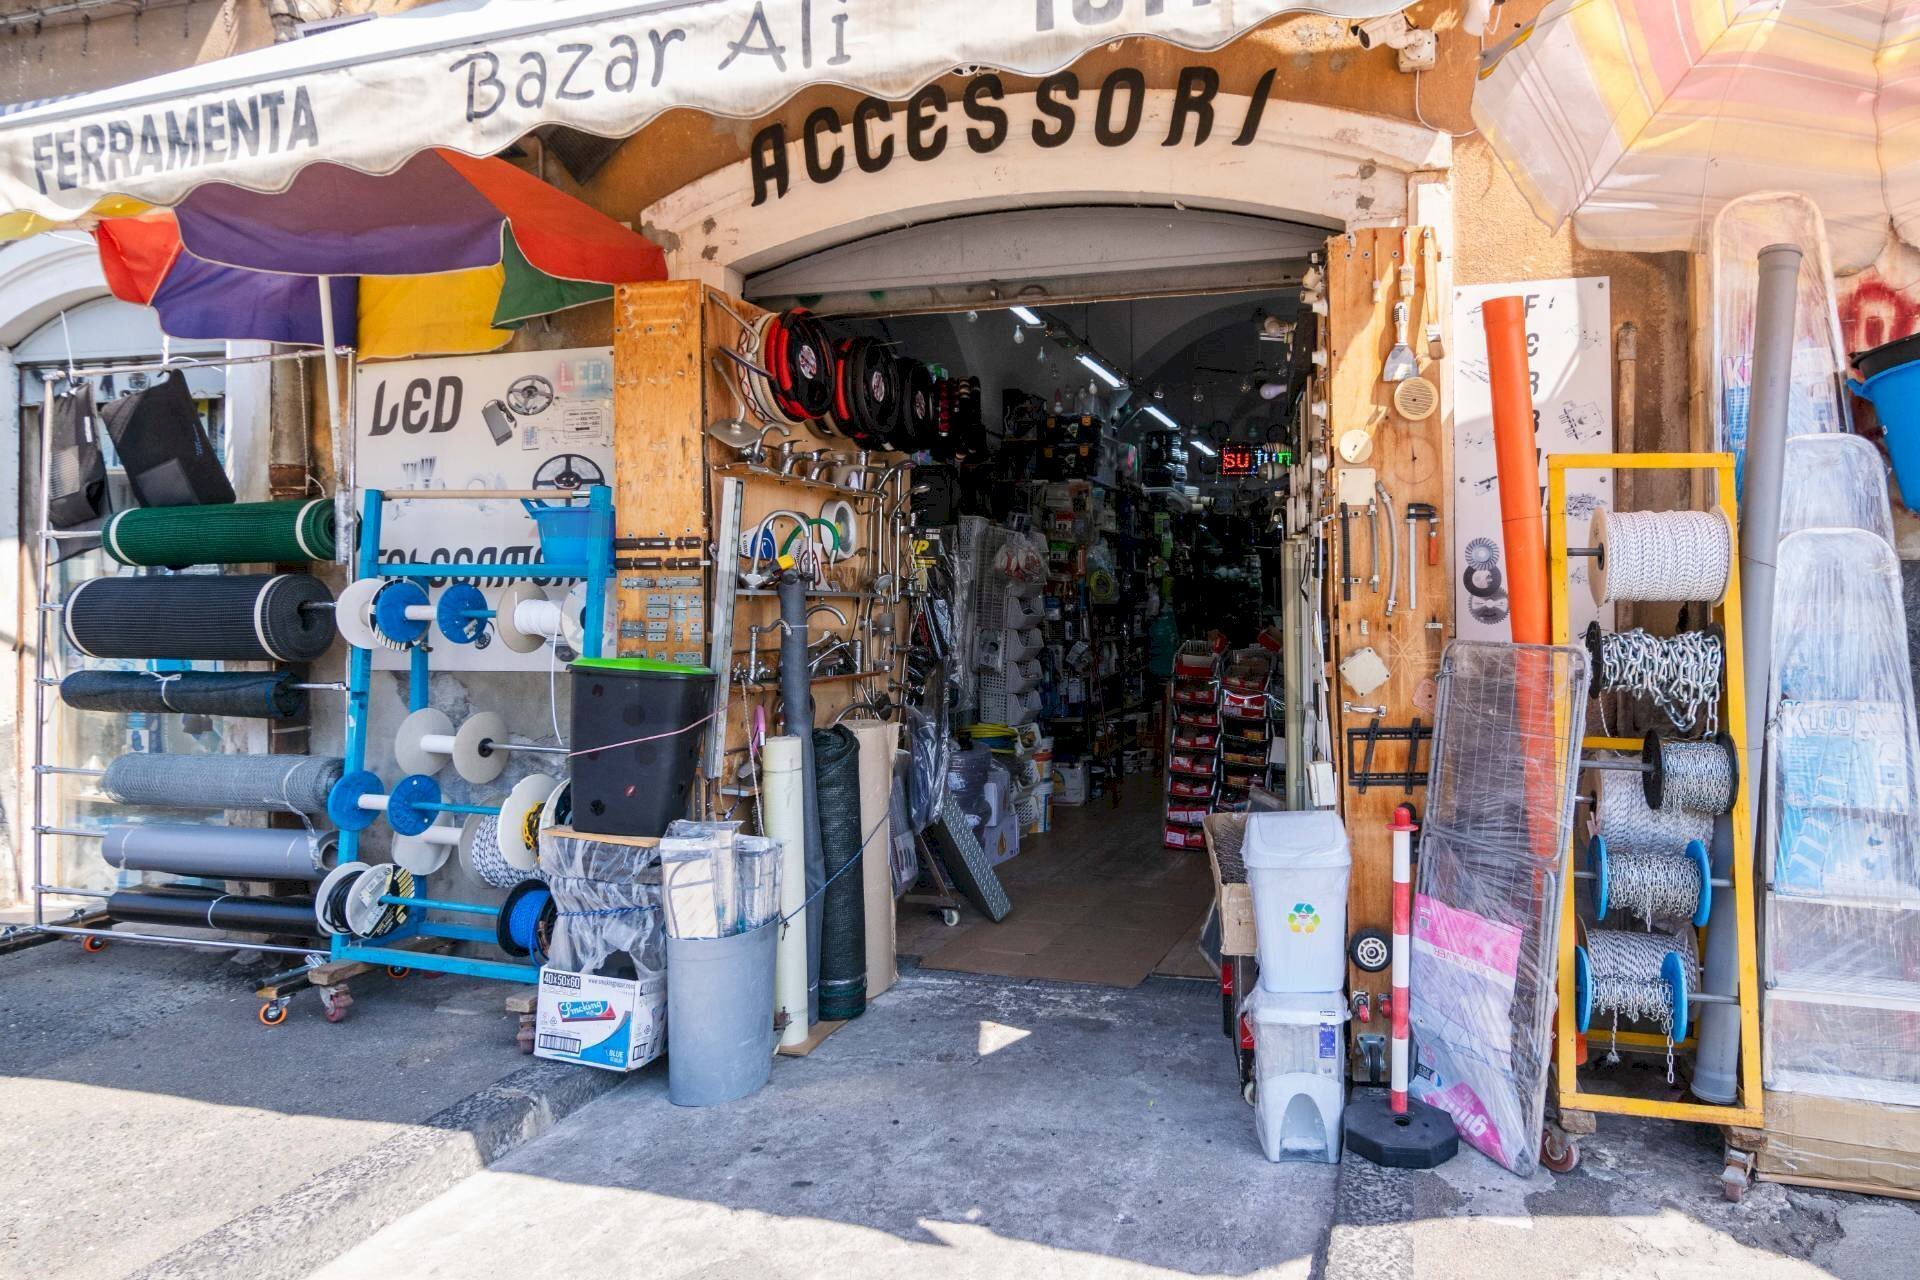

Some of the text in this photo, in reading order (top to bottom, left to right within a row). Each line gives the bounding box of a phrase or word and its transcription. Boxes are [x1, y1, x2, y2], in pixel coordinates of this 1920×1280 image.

[449, 0, 854, 122] Bazar Ali
[32, 85, 319, 196] FERRAMENTA
[750, 66, 1277, 206] ACCESSORI
[367, 375, 464, 437] LED
[543, 971, 581, 989] 40x50x60
